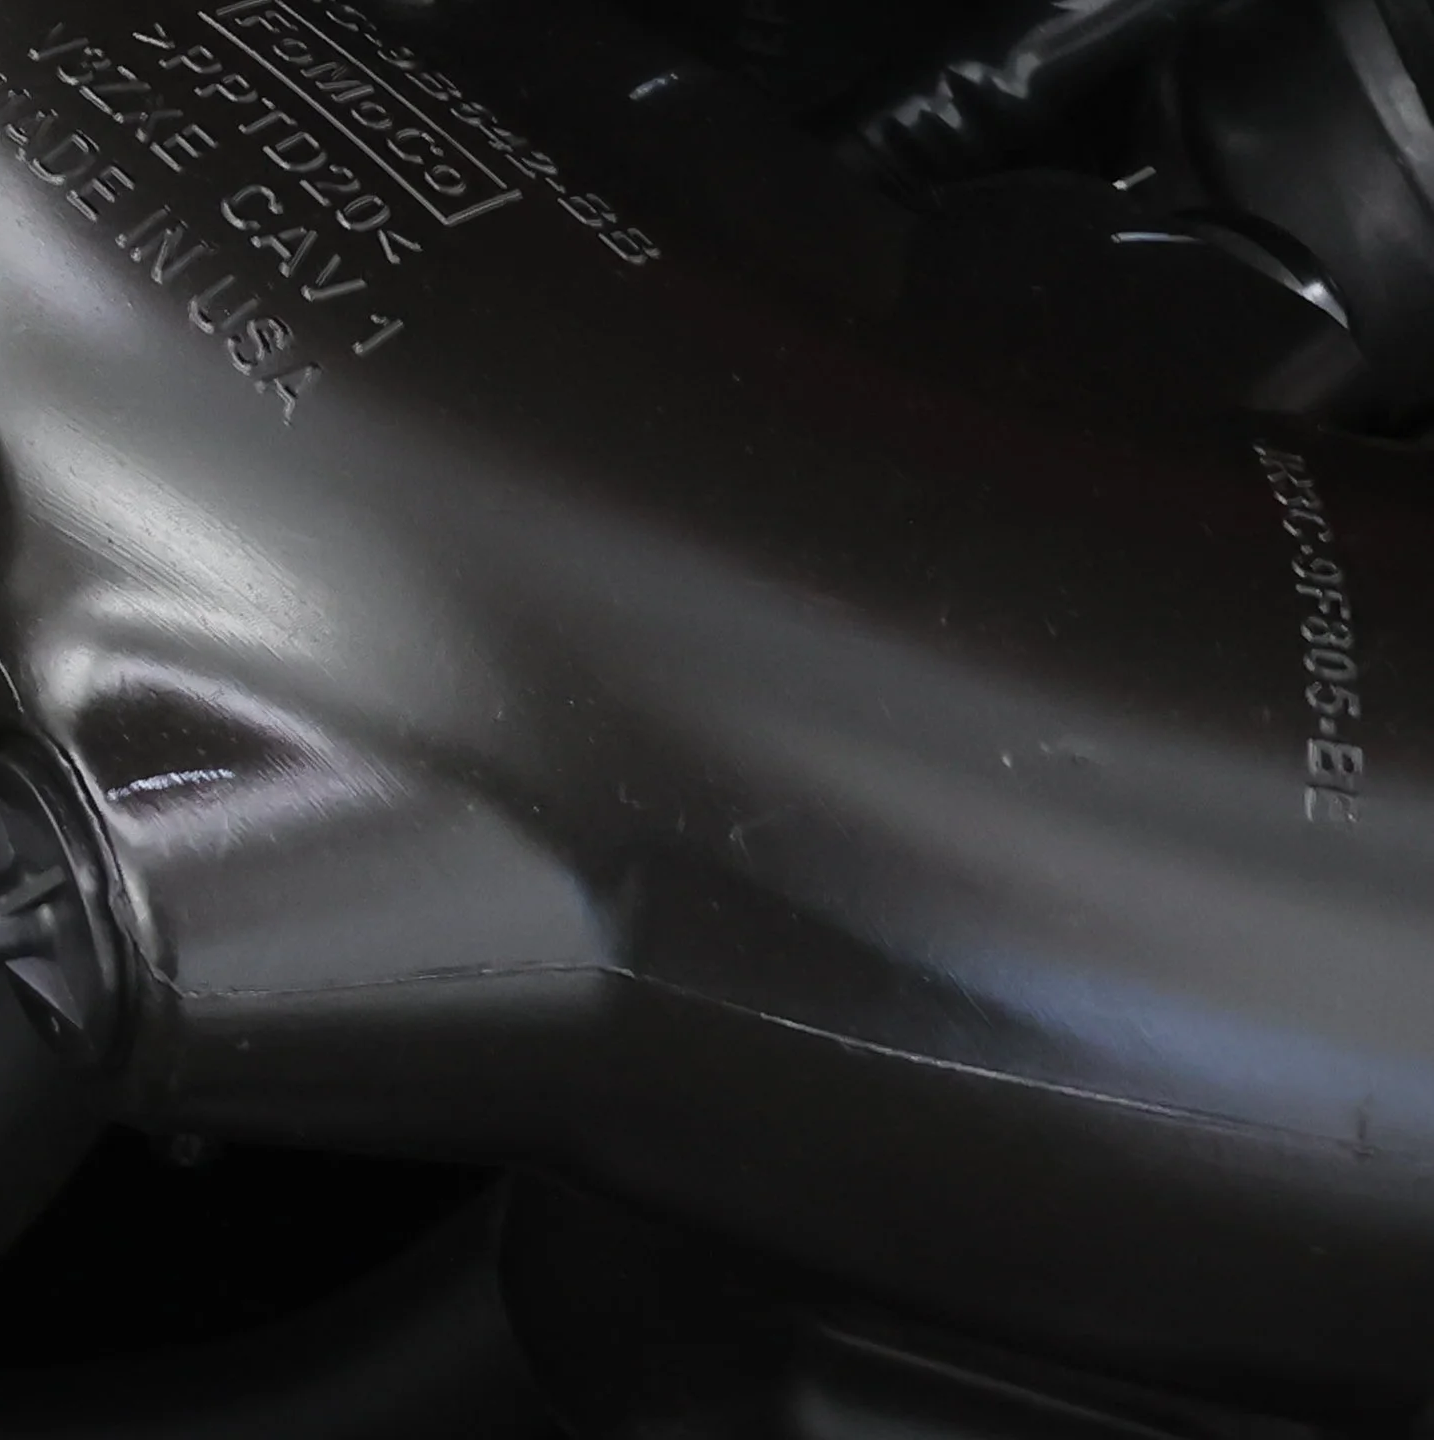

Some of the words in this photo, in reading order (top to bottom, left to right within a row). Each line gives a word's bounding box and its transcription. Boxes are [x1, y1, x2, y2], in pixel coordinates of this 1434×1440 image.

[234, 9, 467, 196] FoMoCo
[115, 202, 220, 288] IN
[187, 272, 325, 426] USA
